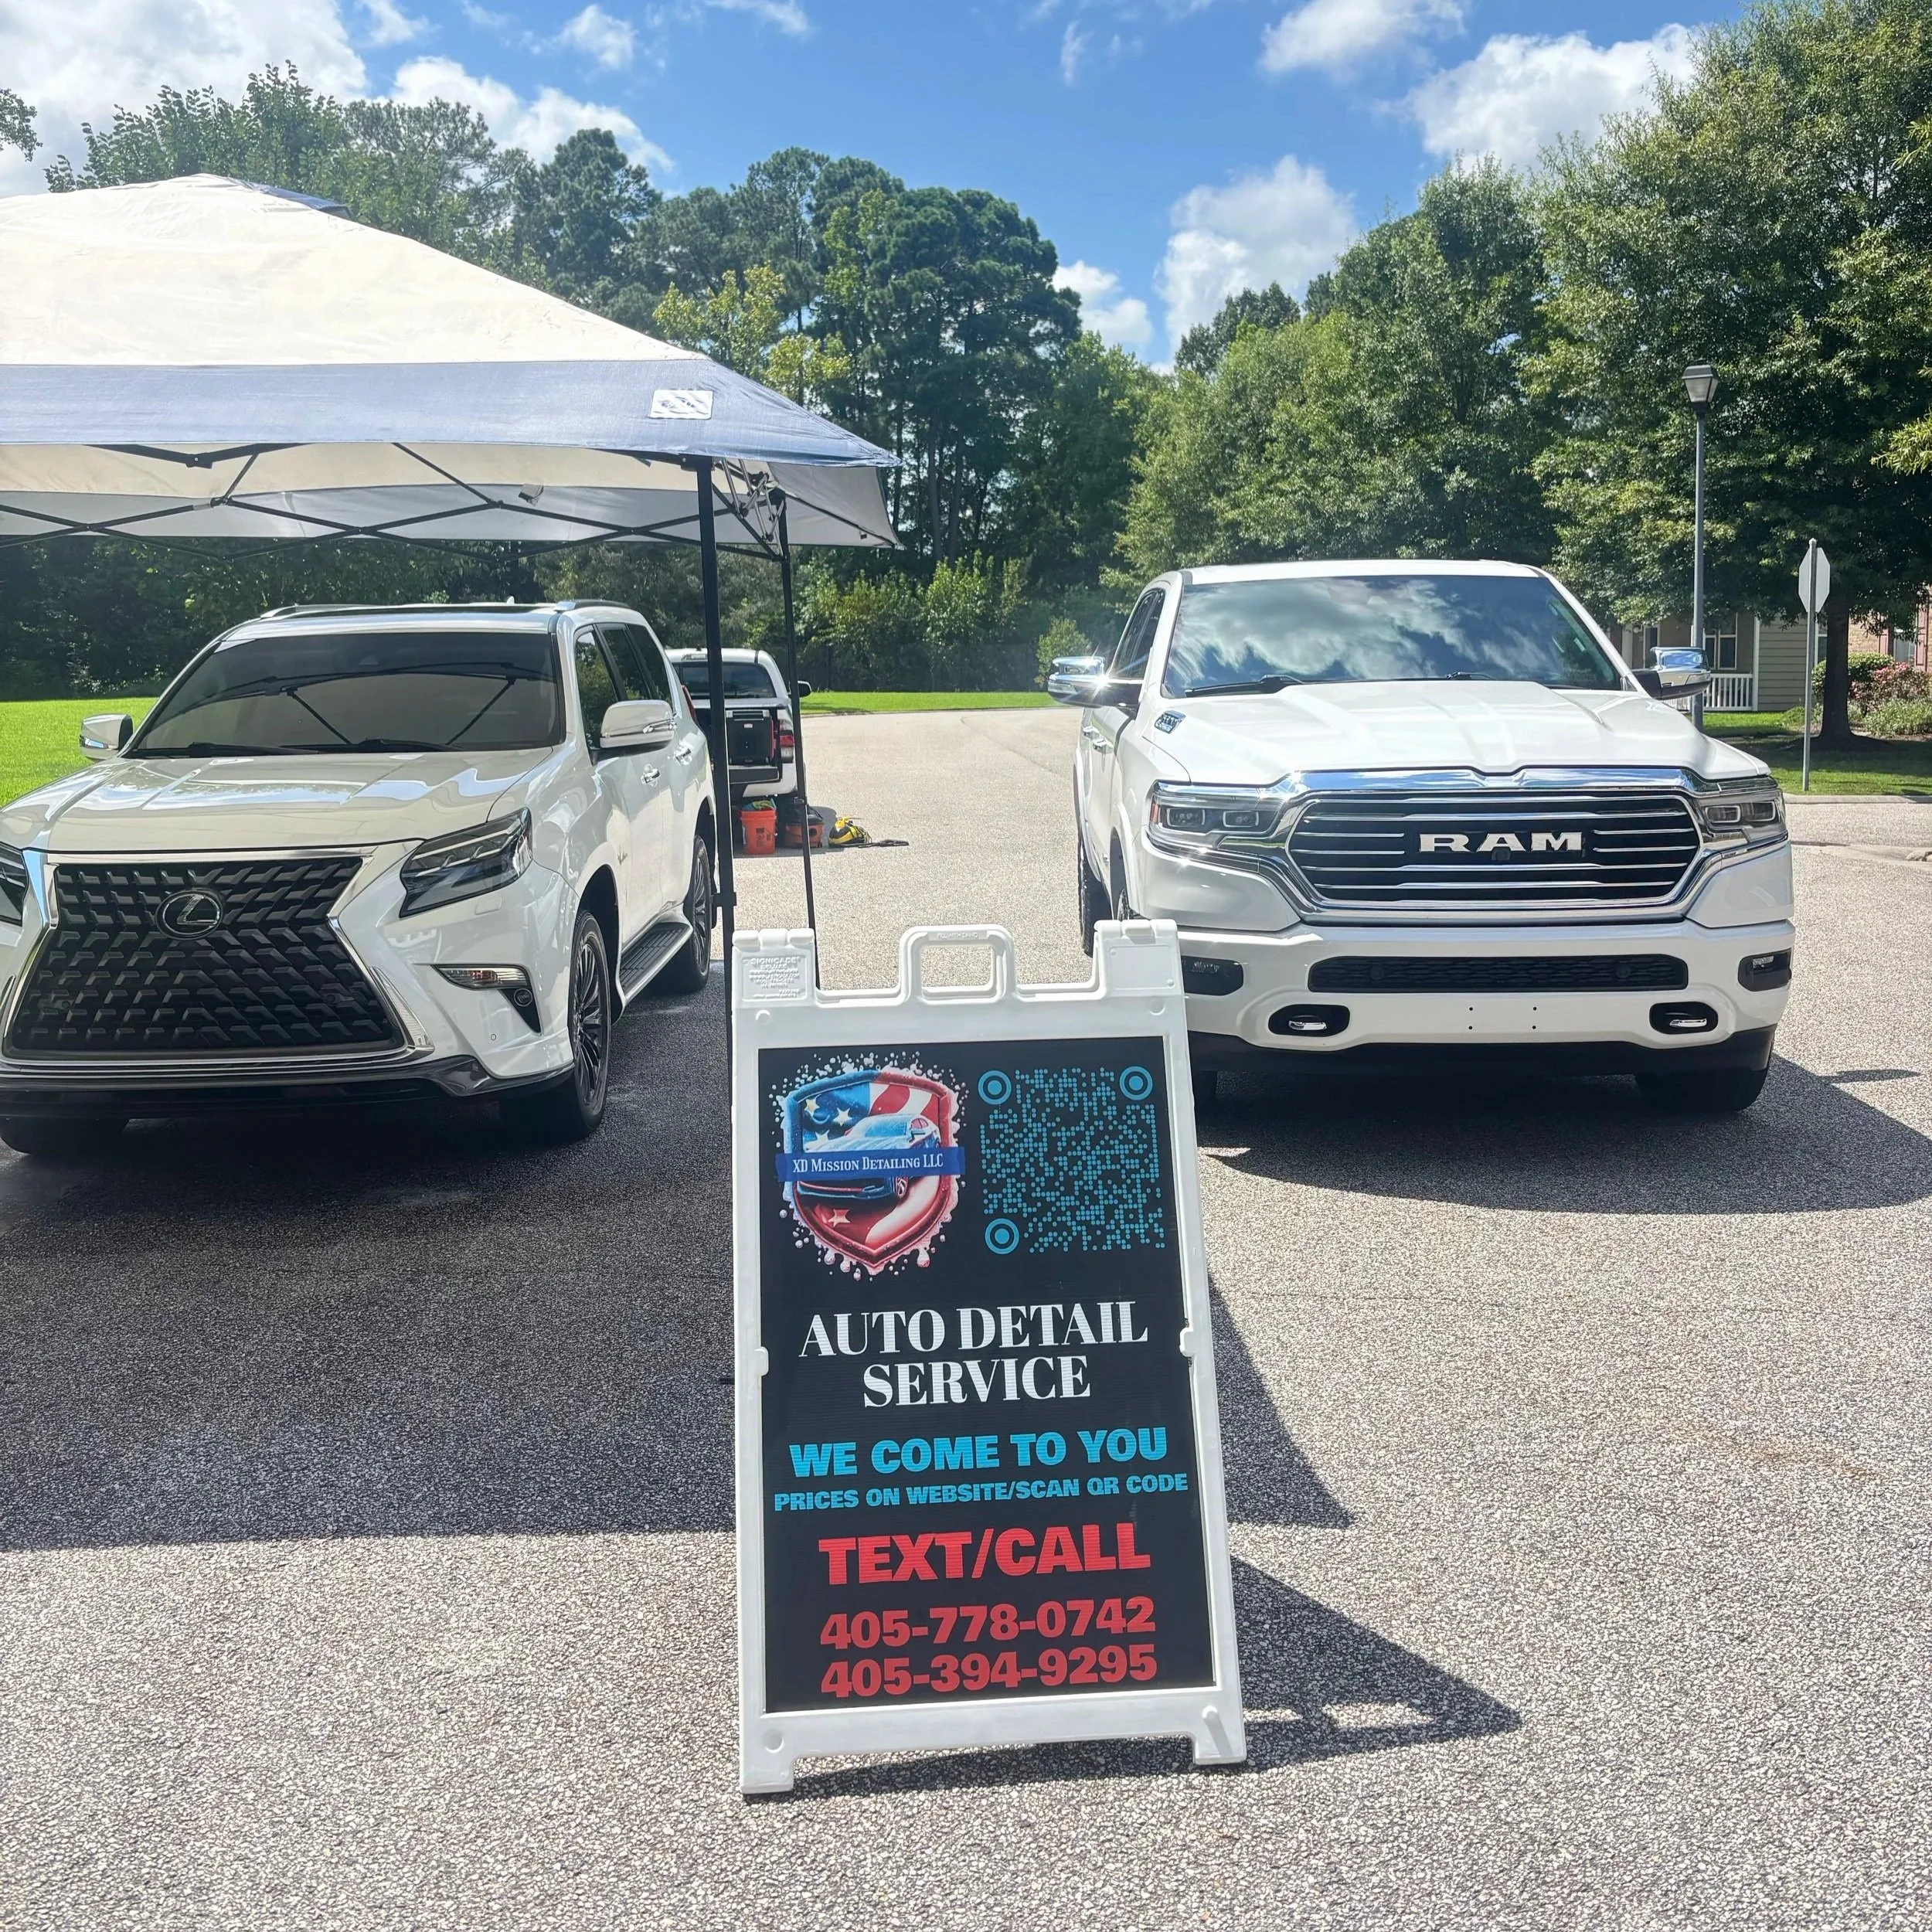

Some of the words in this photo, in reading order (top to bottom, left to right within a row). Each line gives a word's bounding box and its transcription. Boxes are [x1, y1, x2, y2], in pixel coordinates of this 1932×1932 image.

[1419, 832, 1583, 852] RAM
[793, 1158, 808, 1173] XD
[923, 1153, 944, 1168] LLC
[799, 1310, 945, 1357] AUTO
[957, 1301, 1148, 1350] DETAIL
[863, 1355, 1090, 1407] SERVICE
[789, 1441, 858, 1478] WE
[872, 1435, 1000, 1474] COME
[1010, 1432, 1066, 1466] TO
[1077, 1427, 1168, 1464] YOU
[774, 1488, 859, 1511] PRICES
[866, 1487, 900, 1507] ON
[906, 1479, 1080, 1505] WEBSITE/SCAN
[1087, 1476, 1119, 1496] QR
[1126, 1473, 1189, 1494] CODE
[819, 1522, 1151, 1585] TEXT/CALL
[821, 1596, 1156, 1649] 405-778-0742
[821, 1644, 1158, 1698] 405-394-9295
